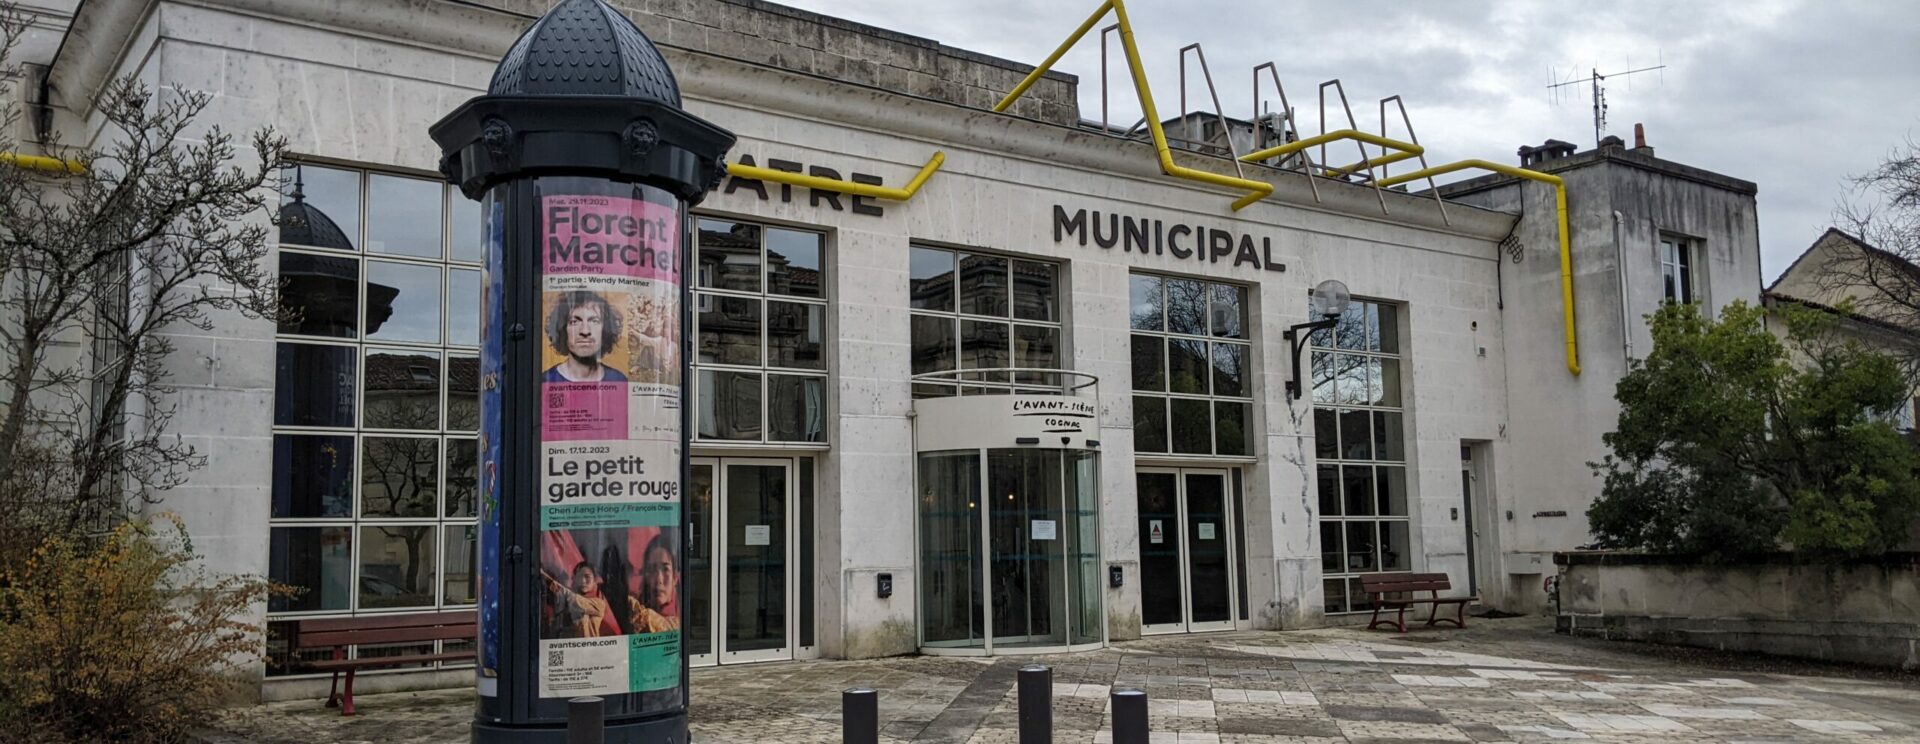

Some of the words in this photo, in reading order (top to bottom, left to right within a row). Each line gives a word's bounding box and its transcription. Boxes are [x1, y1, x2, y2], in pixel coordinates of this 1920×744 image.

[709, 154, 884, 217] ATRE
[549, 206, 667, 243] Florent
[1053, 204, 1286, 272] MUNICIPAL
[549, 236, 678, 274] Marchet
[549, 265, 580, 273] Garden
[582, 265, 605, 275] Party
[557, 276, 583, 285] partie
[588, 276, 617, 286] Wendy
[618, 278, 650, 287] Martinez
[549, 383, 618, 392] avantscene.com
[1045, 418, 1081, 428] COGNAC
[548, 447, 567, 455] Dim.
[568, 447, 610, 455] 17.12.2023
[548, 457, 578, 476] Le
[586, 456, 644, 480] petit
[548, 477, 623, 503] garde
[629, 480, 677, 500] rouge
[548, 507, 571, 515] Chen
[572, 506, 596, 514] Jiang
[597, 505, 620, 514] Hong
[549, 639, 618, 649] avantscene.com
